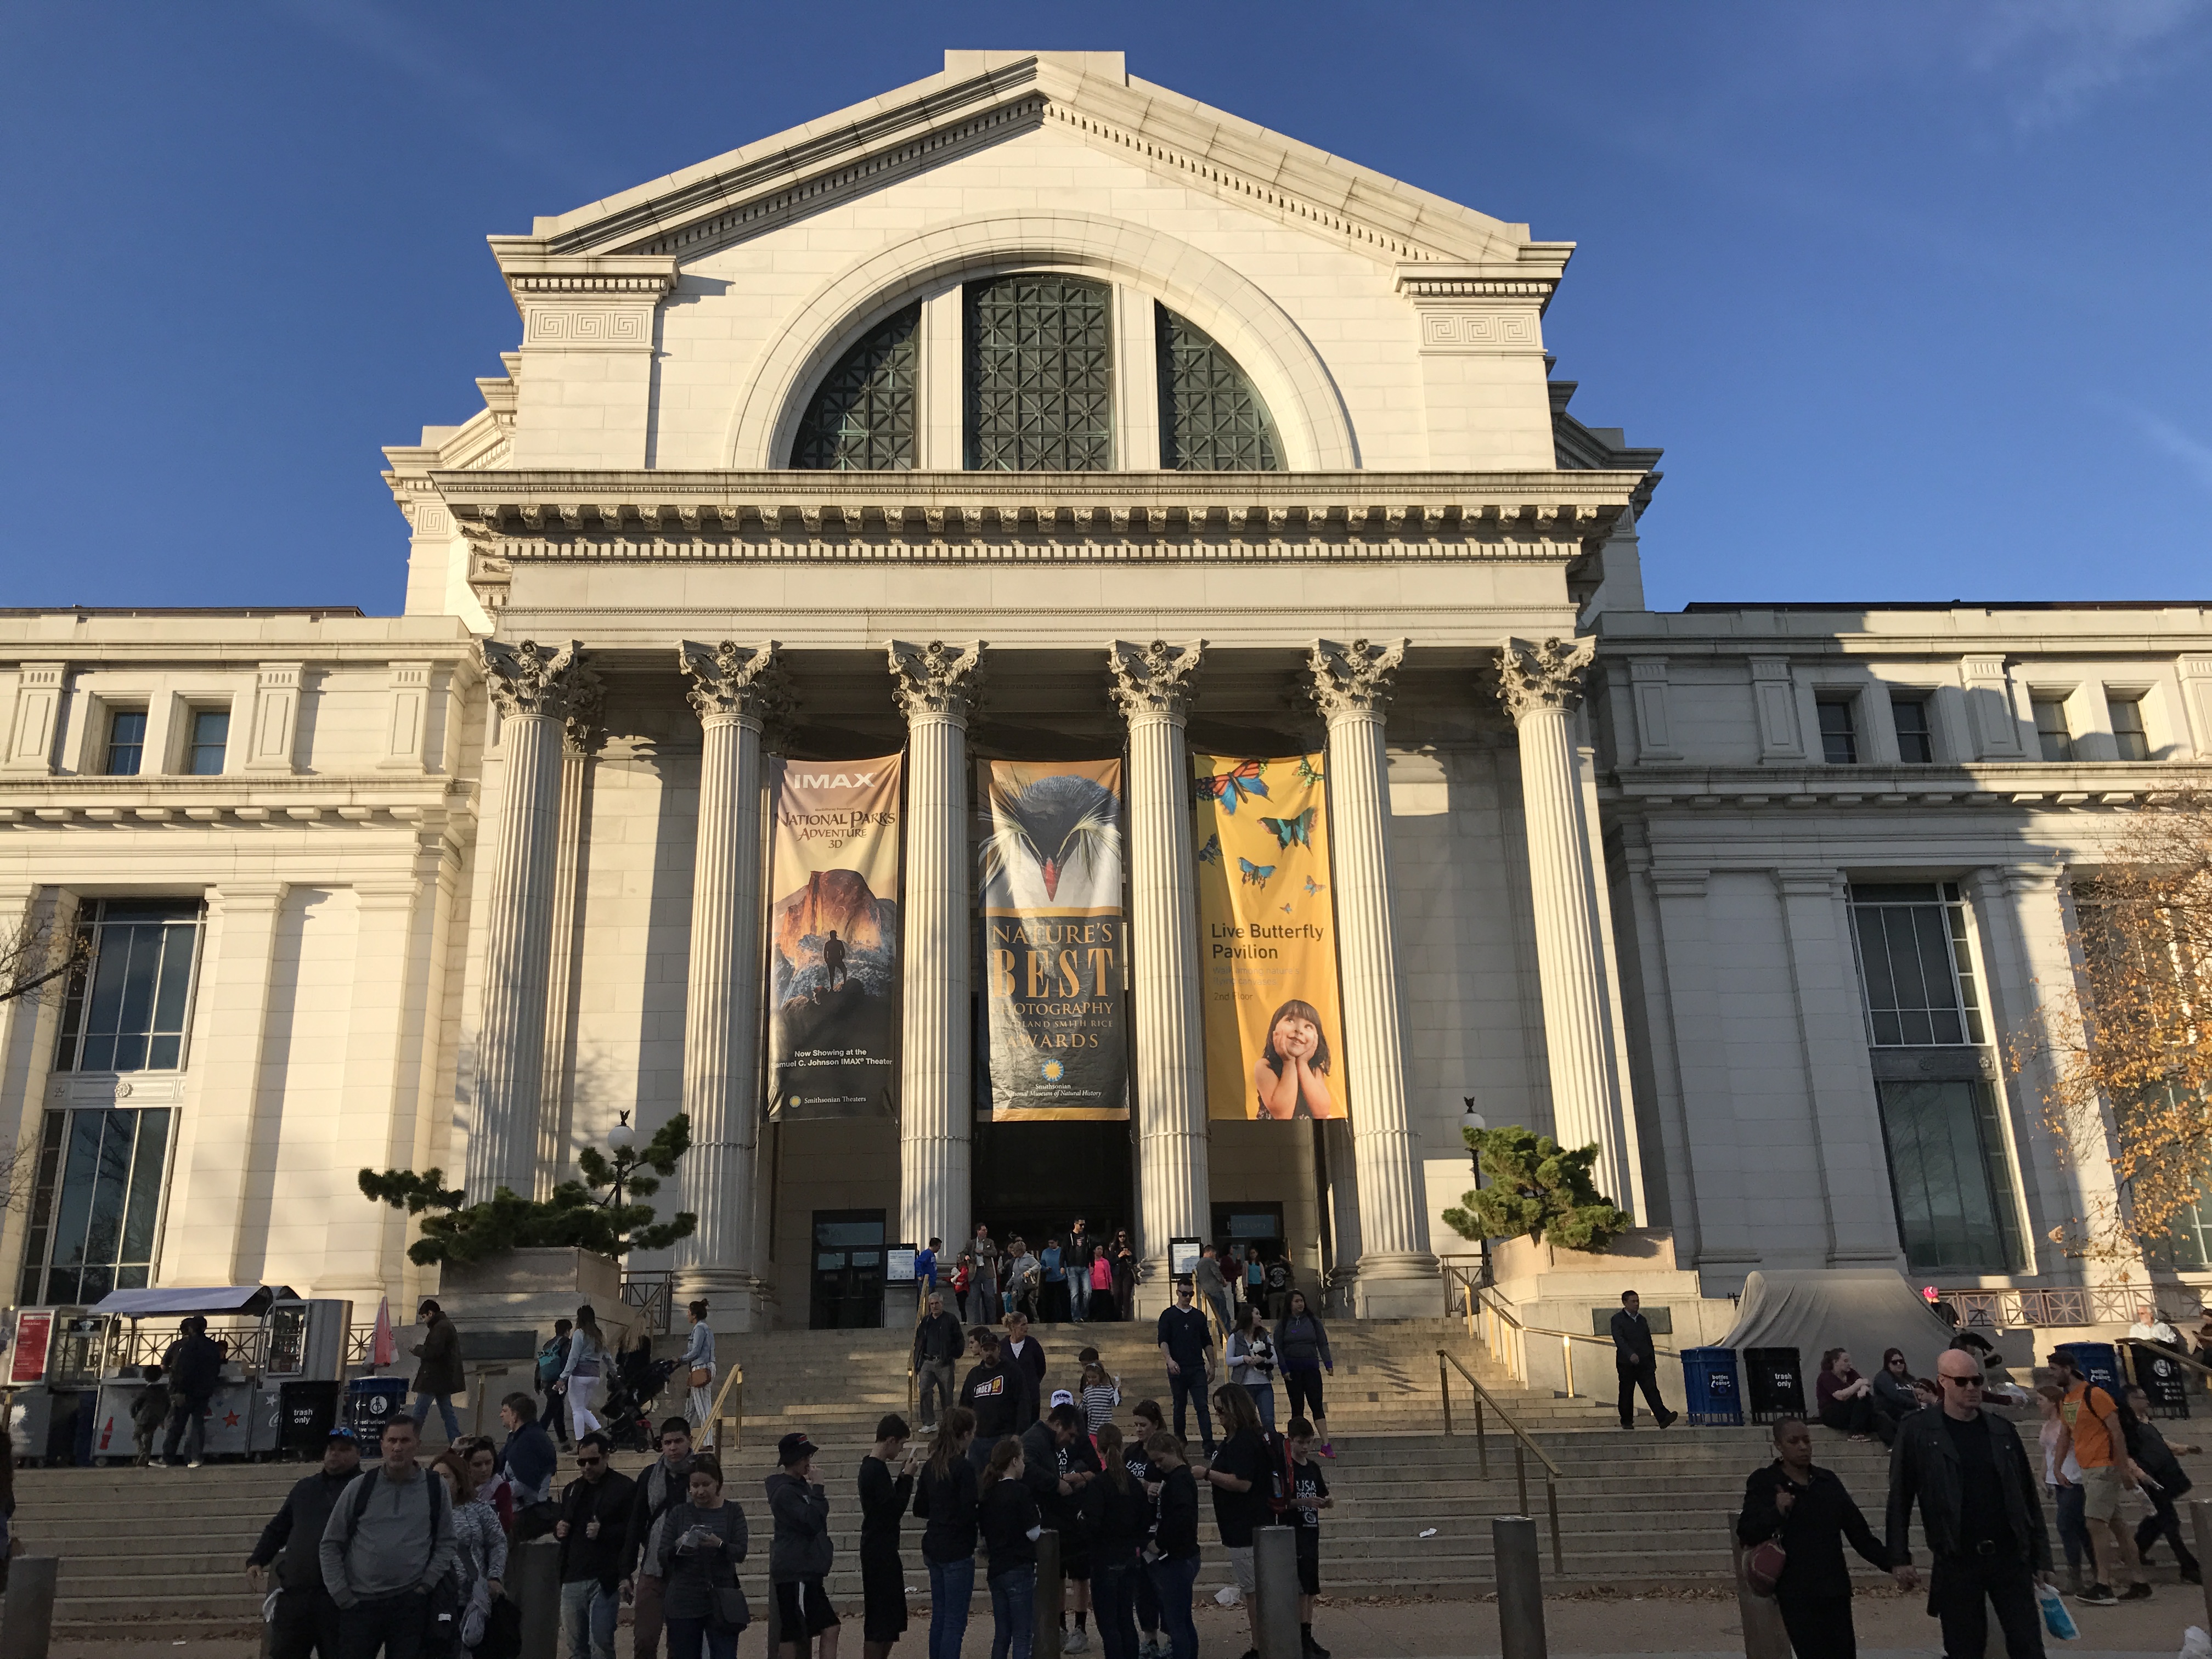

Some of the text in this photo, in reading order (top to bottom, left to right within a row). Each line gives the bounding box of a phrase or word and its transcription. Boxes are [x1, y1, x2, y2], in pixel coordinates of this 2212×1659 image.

[794, 772, 875, 789] IMAX
[774, 811, 895, 828] NATIONAL PARKS
[796, 827, 867, 842] ADVENTURE
[828, 839, 843, 849] 3D
[992, 923, 1113, 944] NATURE'S
[1211, 923, 1324, 941] Live Butterfly
[1212, 944, 1278, 959] Pavilion
[992, 948, 1114, 998] BEST
[1212, 966, 1300, 977] Walk among nature's
[1214, 992, 1254, 1001] 2nd Floor
[992, 1002, 1114, 1015] PHOTOGRAPHY
[1007, 1034, 1098, 1048] AWARDS
[771, 1060, 797, 1069] Samuel
[1053, 1090, 1060, 1098] of
[992, 1379, 1001, 1389] UP
[1777, 1380, 1791, 1389] only
[294, 1417, 311, 1425] only
[1126, 1460, 1147, 1471] USA
[1296, 1480, 1317, 1492] USA
